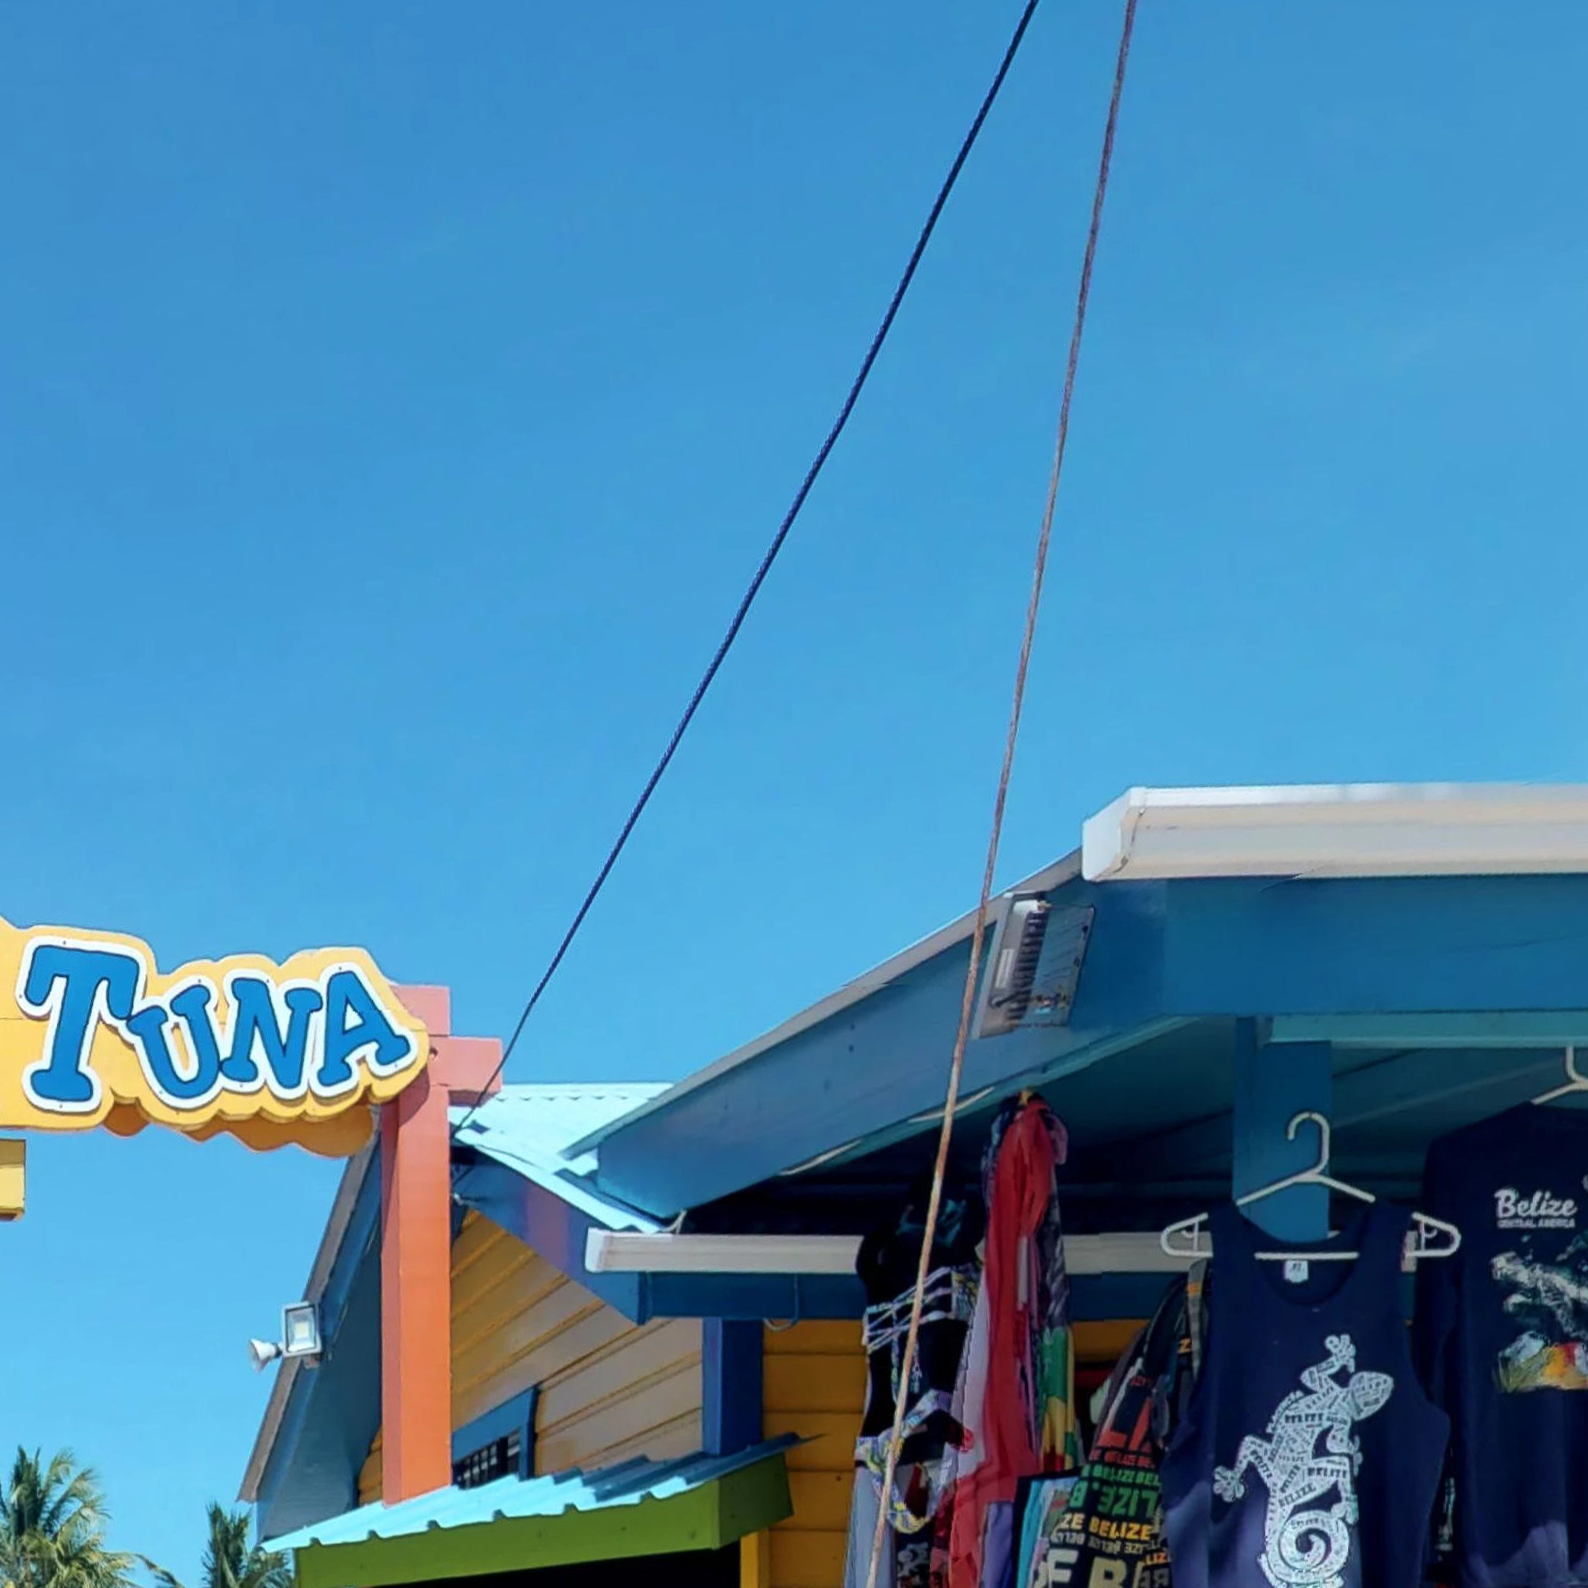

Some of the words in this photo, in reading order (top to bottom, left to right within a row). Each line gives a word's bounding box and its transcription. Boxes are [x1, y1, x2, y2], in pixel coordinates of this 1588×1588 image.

[21, 942, 413, 1103] TUNA
[1493, 1187, 1579, 1219] Belize
[1088, 1513, 1154, 1541] BELIZE
